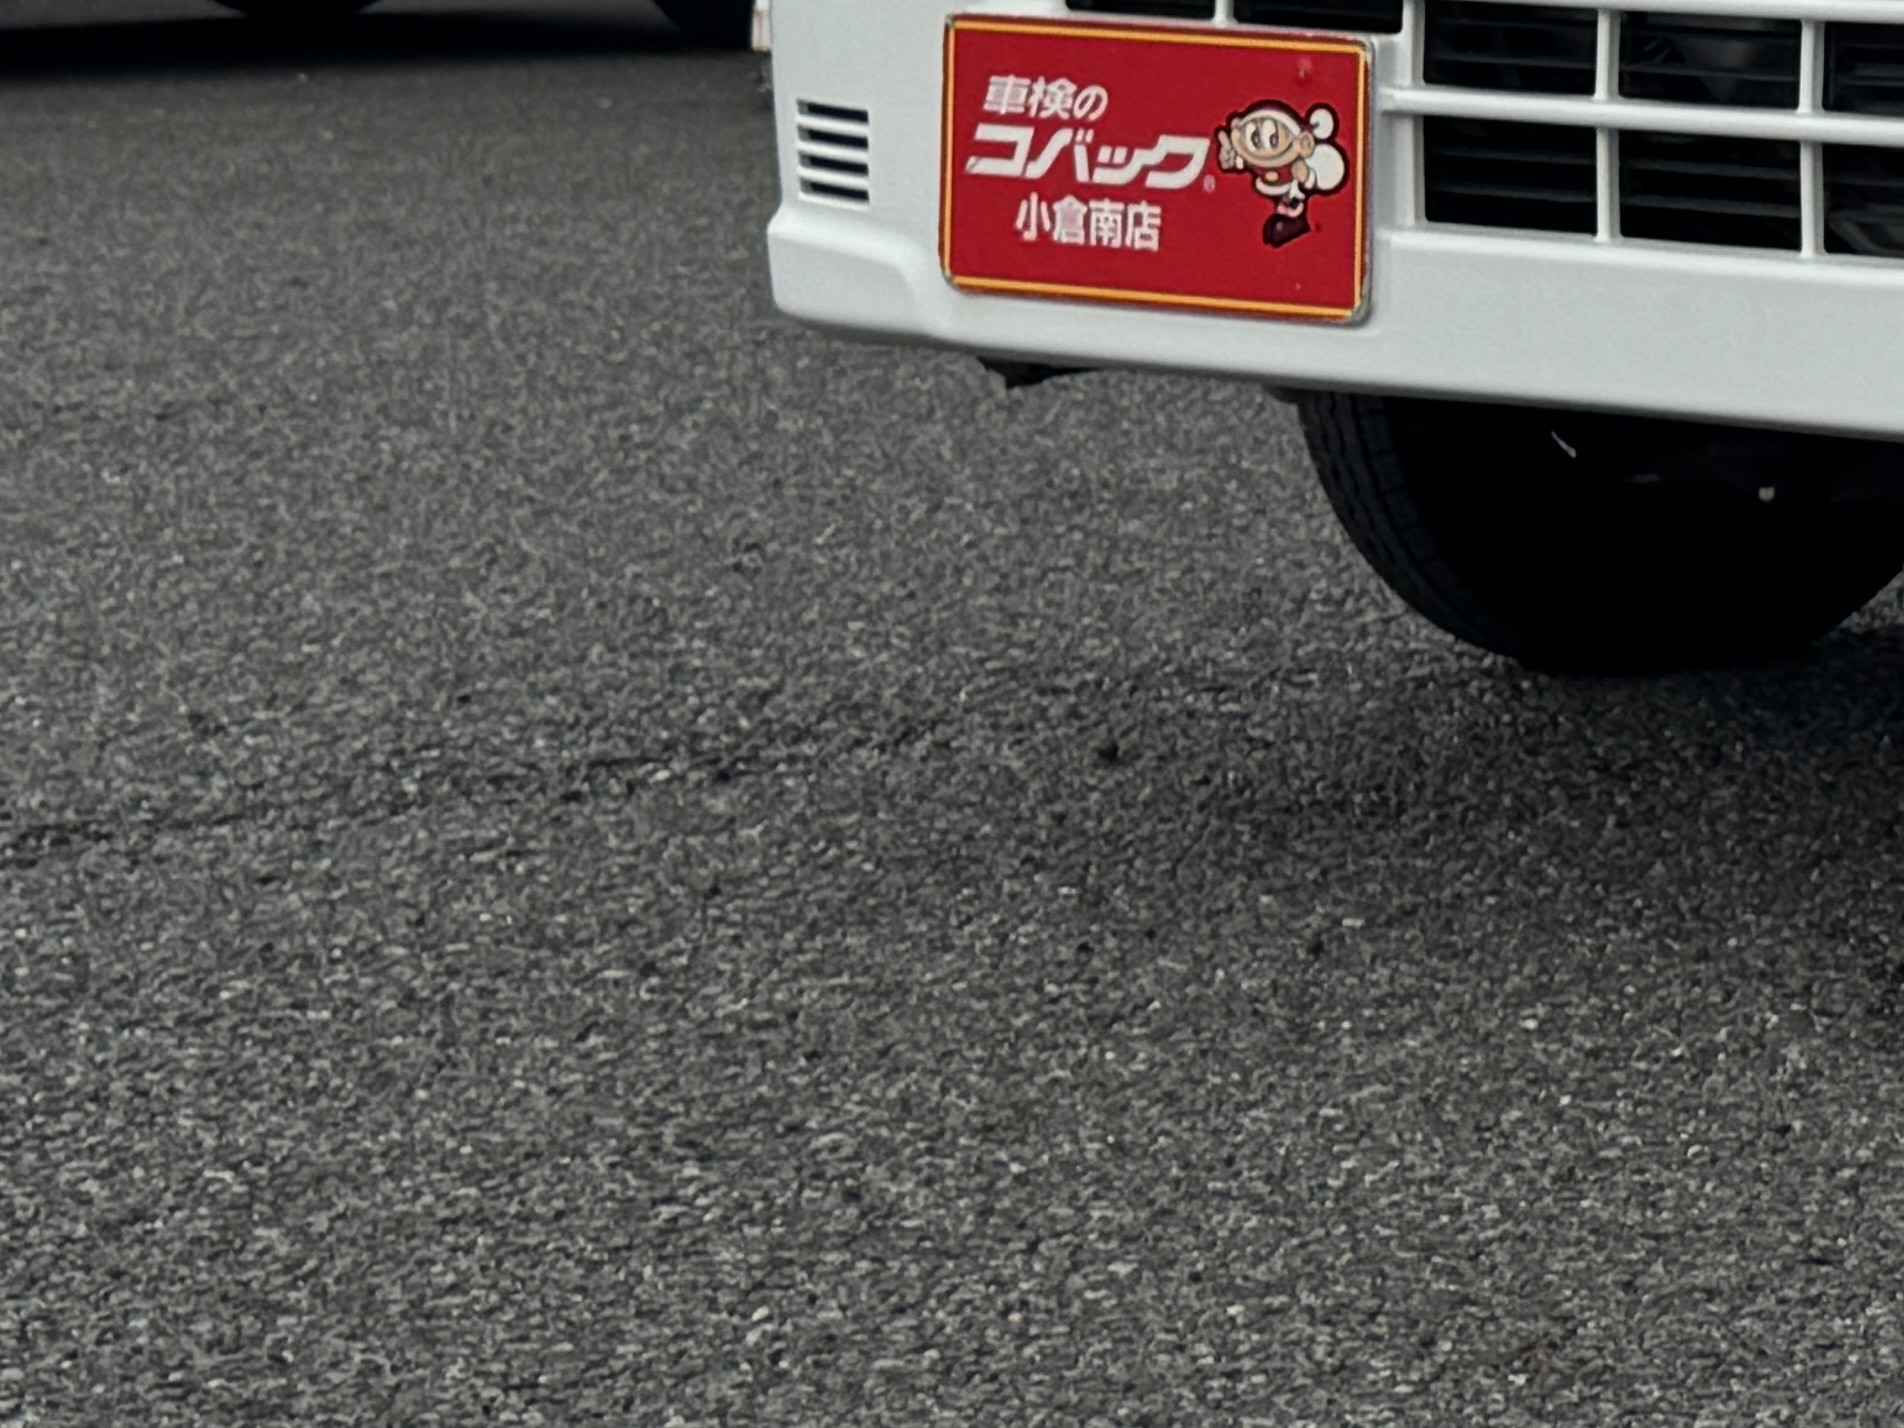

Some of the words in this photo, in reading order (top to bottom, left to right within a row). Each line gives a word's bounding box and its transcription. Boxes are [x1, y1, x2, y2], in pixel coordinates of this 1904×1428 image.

[983, 74, 1109, 122] 車検の
[964, 122, 1211, 191] コバック
[1013, 191, 1163, 252] 小倉南店
